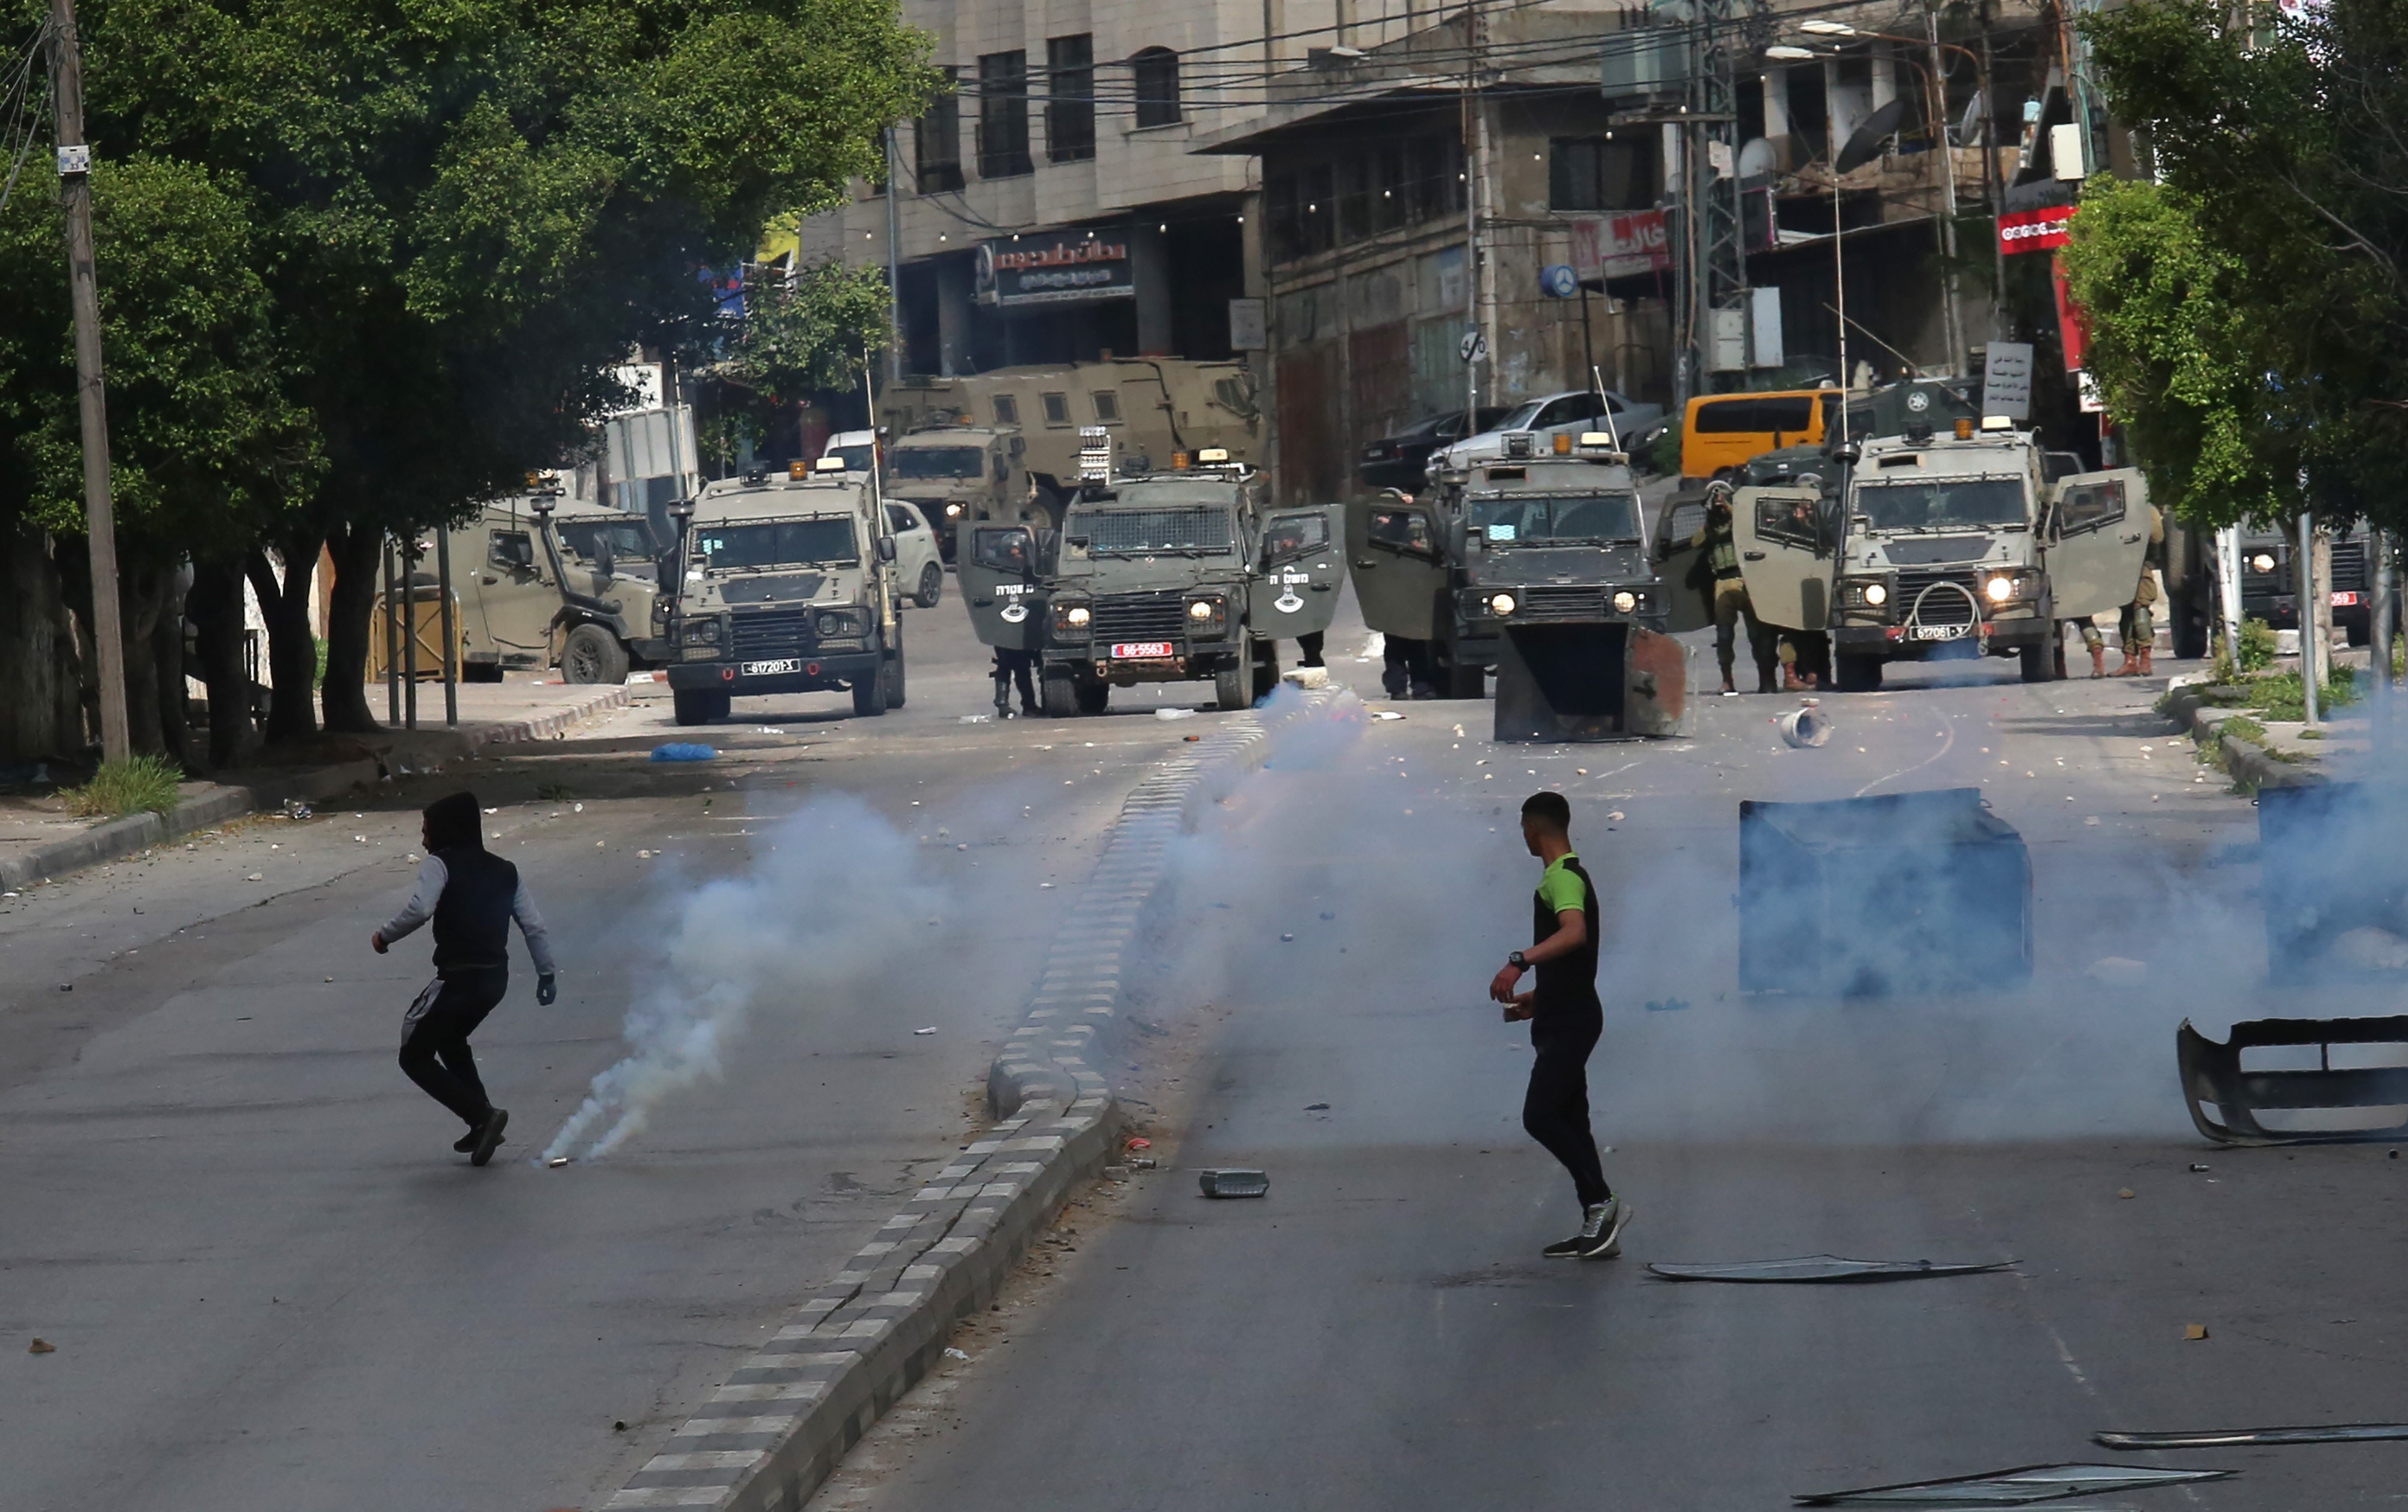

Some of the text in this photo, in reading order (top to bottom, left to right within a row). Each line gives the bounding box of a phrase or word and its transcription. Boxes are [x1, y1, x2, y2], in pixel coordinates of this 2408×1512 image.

[1461, 340, 1486, 354] 40
[995, 584, 1034, 596] משטרה
[1123, 644, 1164, 656] 66-5563
